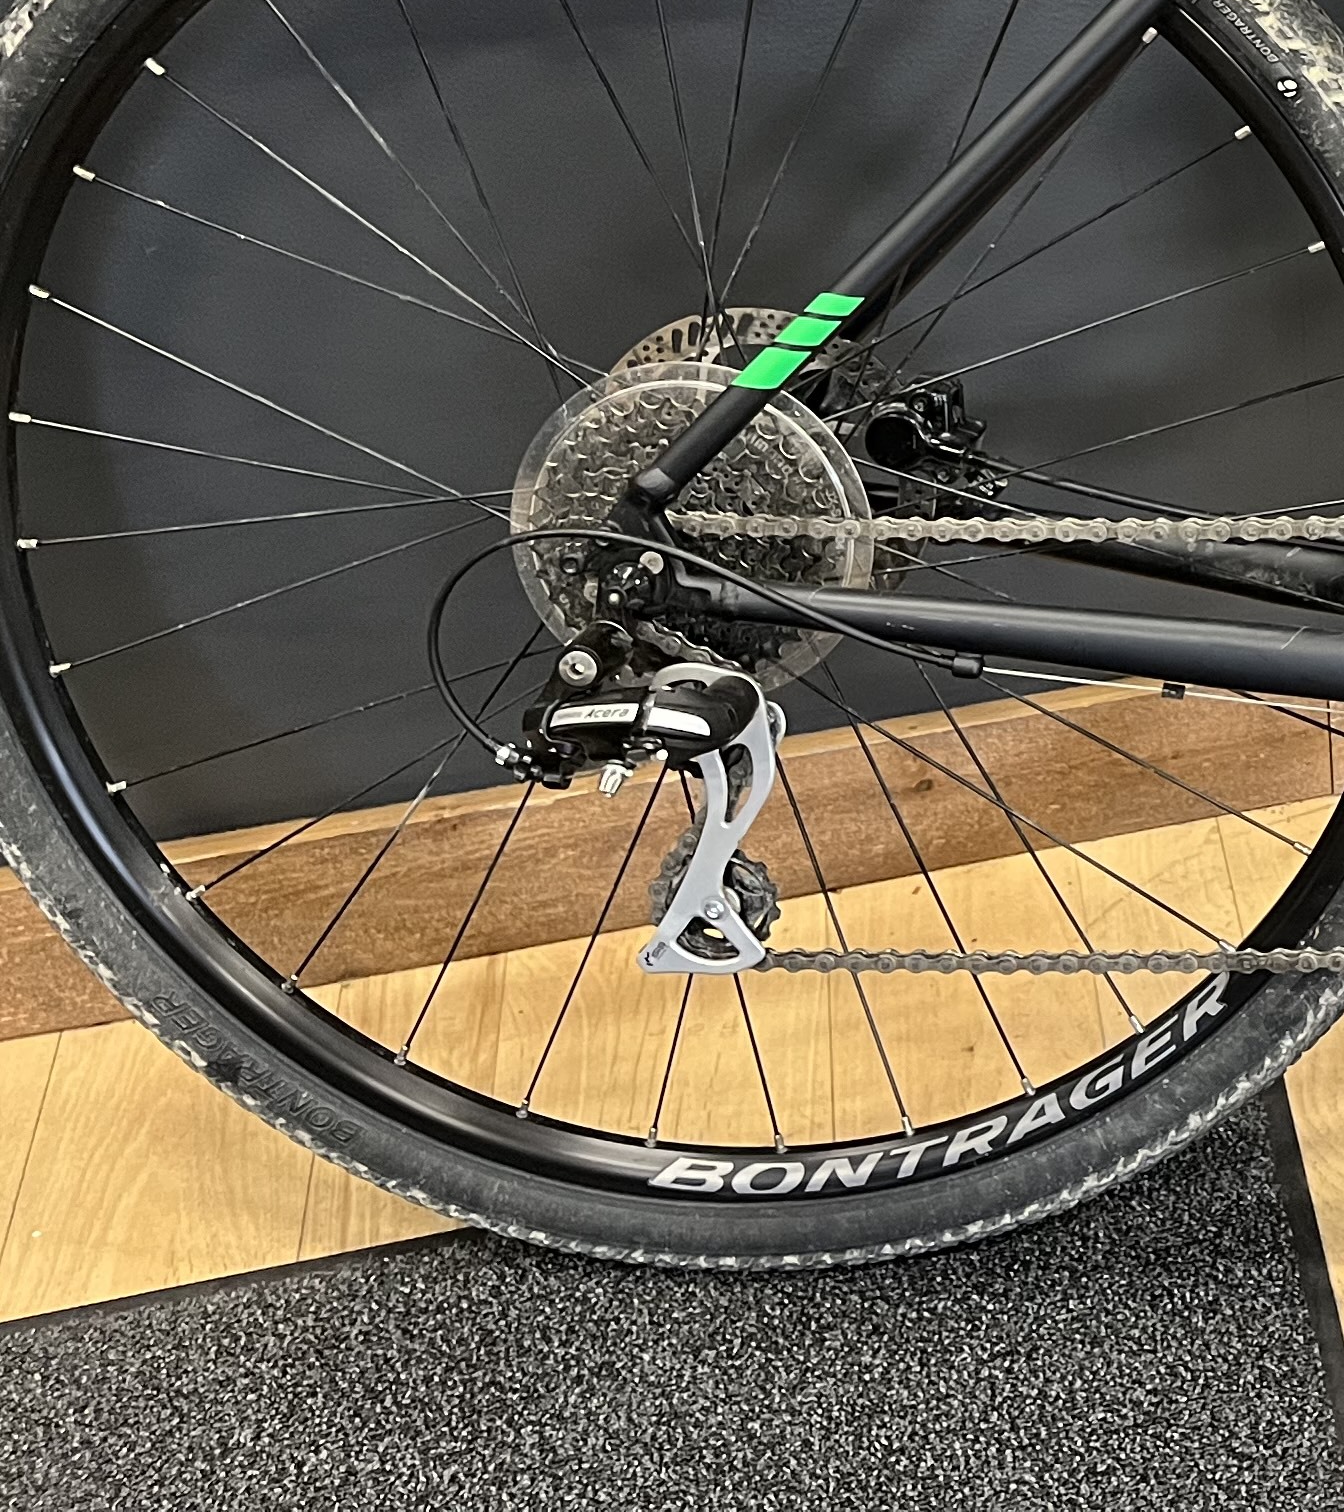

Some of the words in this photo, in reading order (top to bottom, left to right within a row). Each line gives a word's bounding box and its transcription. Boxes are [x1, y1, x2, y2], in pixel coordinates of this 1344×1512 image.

[1212, 0, 1279, 63] BONTRAGER
[584, 708, 630, 719] Acera
[151, 990, 361, 1145] BONTRAGER
[648, 972, 1229, 1194] BONTRAGER
